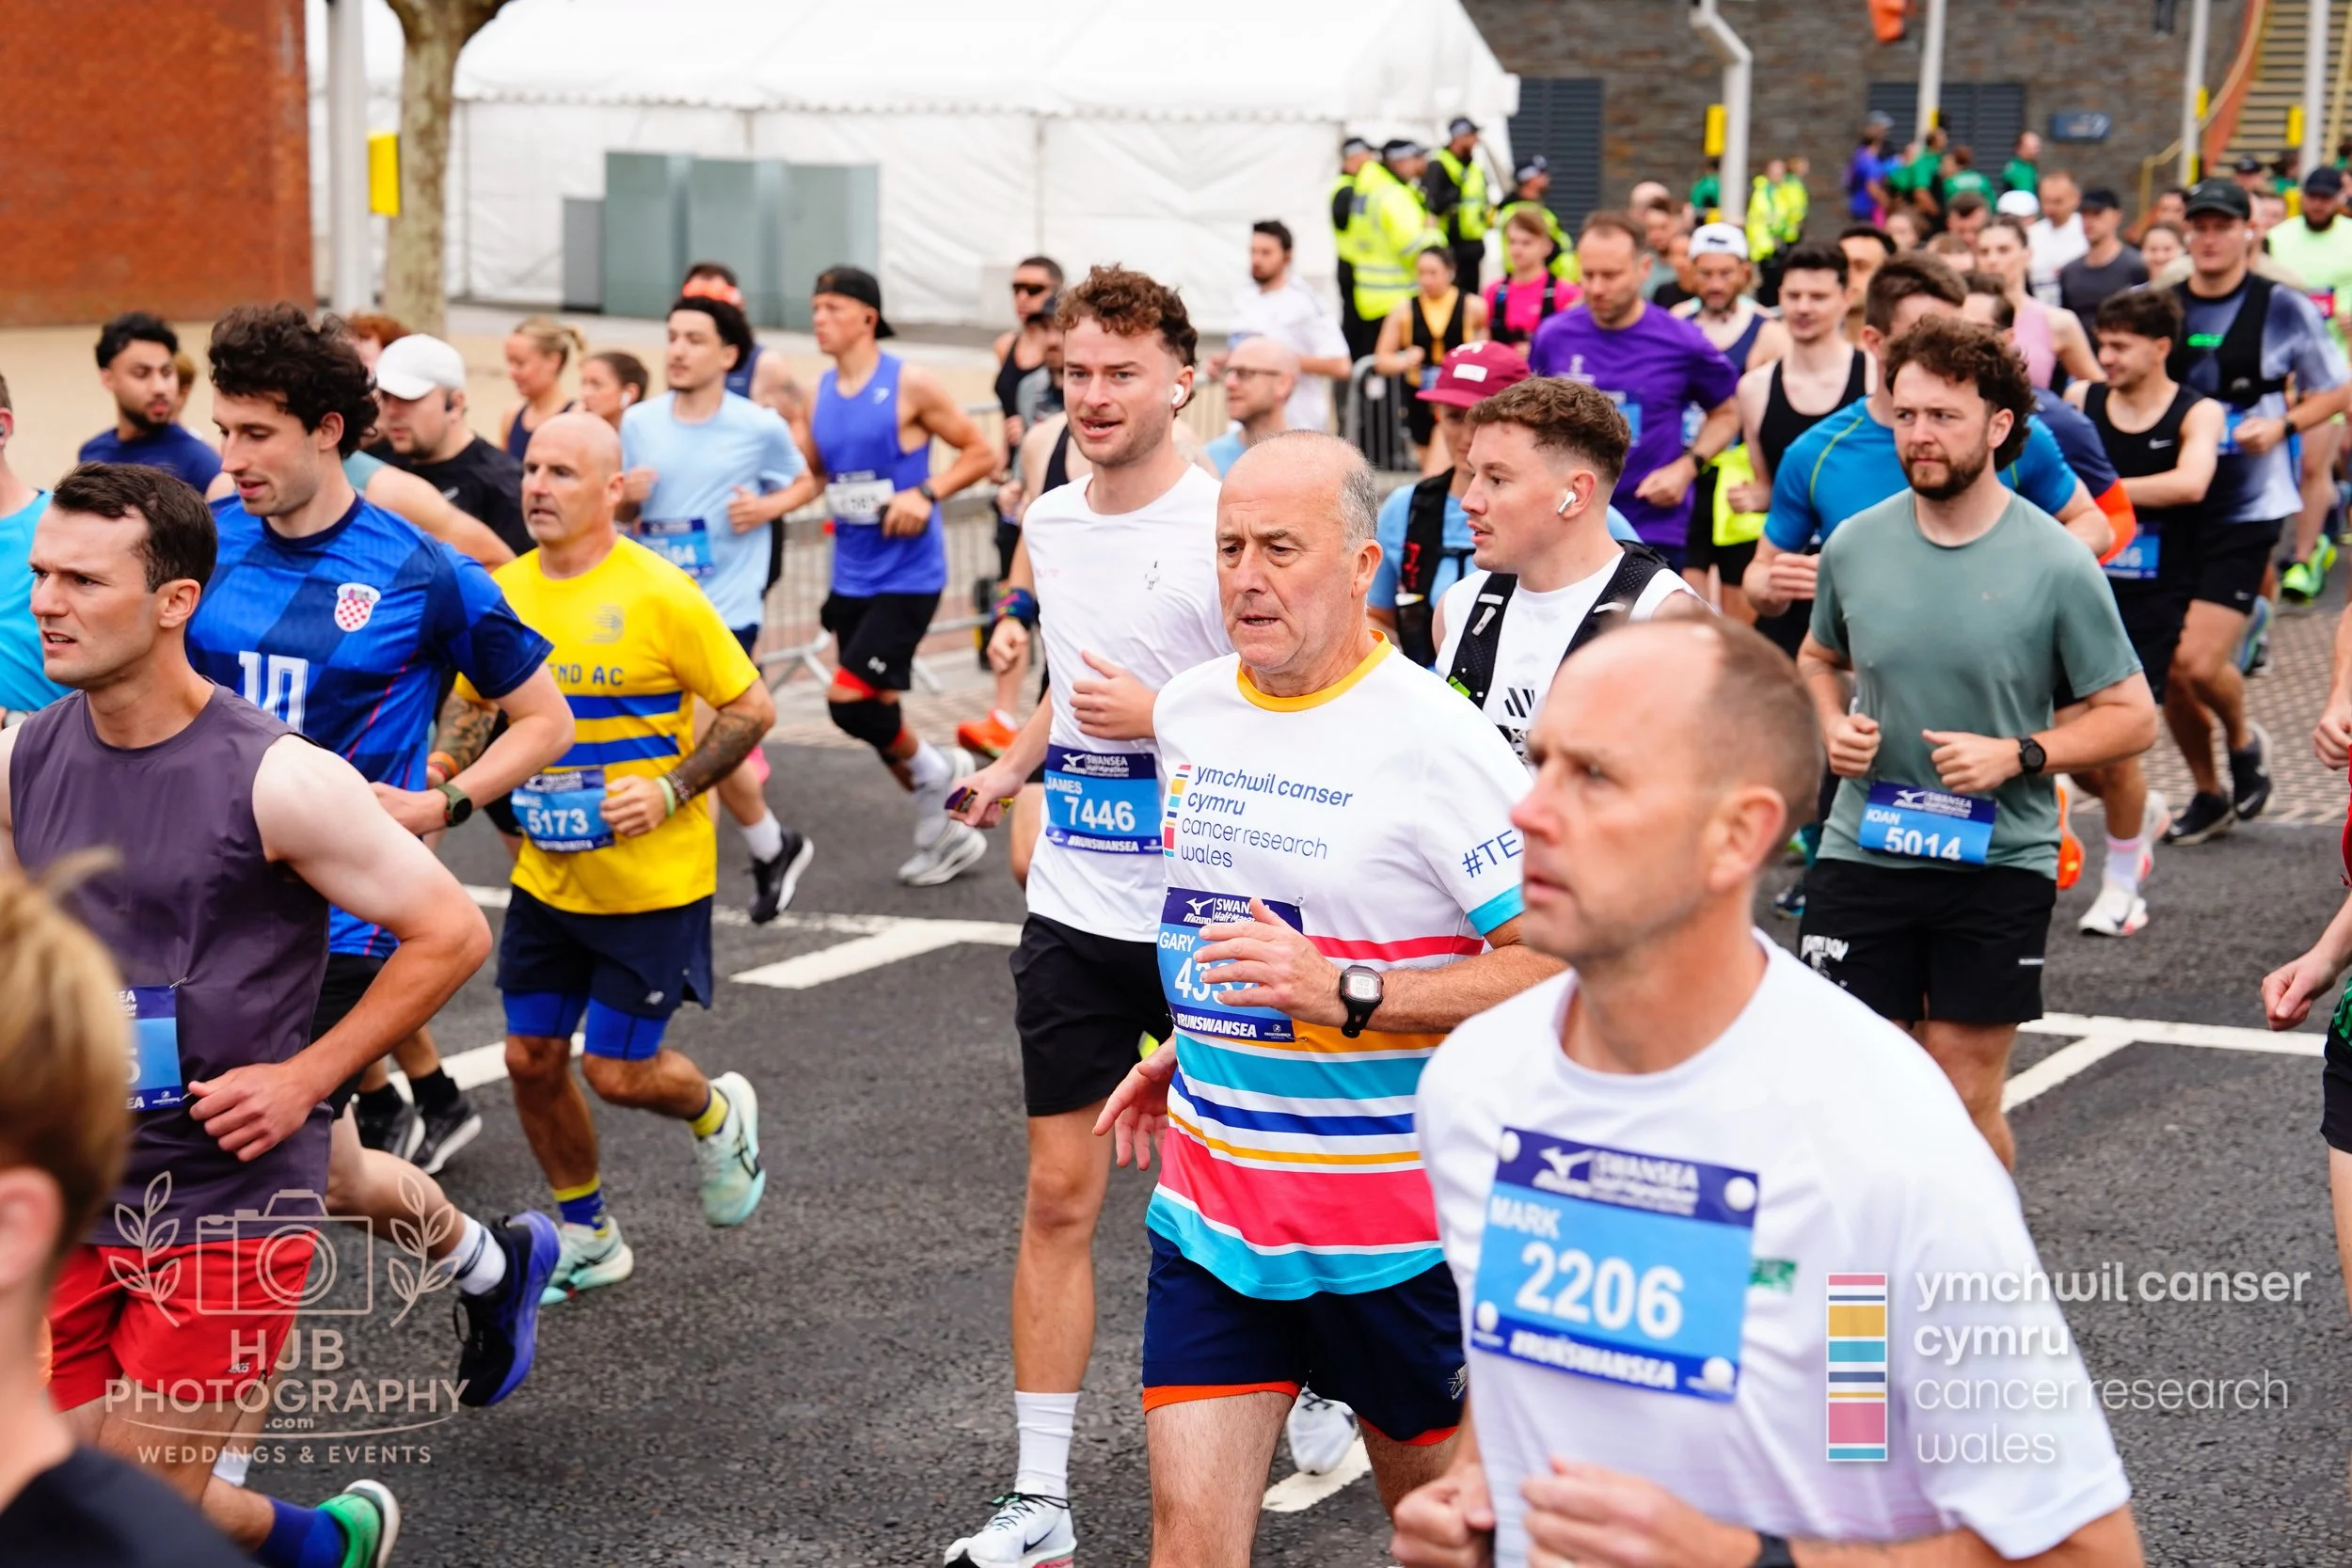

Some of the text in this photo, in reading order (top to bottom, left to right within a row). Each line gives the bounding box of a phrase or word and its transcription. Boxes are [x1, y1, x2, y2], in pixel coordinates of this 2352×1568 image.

[549, 663, 624, 686] ND AC
[238, 650, 309, 734] 10
[1045, 776, 1083, 795] JAMES
[1195, 766, 1353, 807] ymchwil canser
[1064, 795, 1136, 832] 7446
[1187, 791, 1246, 816] cymru
[1866, 808, 1901, 825] IOAN
[527, 808, 589, 835] 5173
[1182, 817, 1327, 860] cancer research
[1883, 826, 1962, 862] 5014
[1181, 844, 1232, 868] wales
[1159, 931, 1196, 953] GARY
[1176, 1012, 1258, 1038] #RUNSWANSEA
[1489, 1194, 1562, 1241] MARK
[1515, 1240, 1685, 1340] 2206
